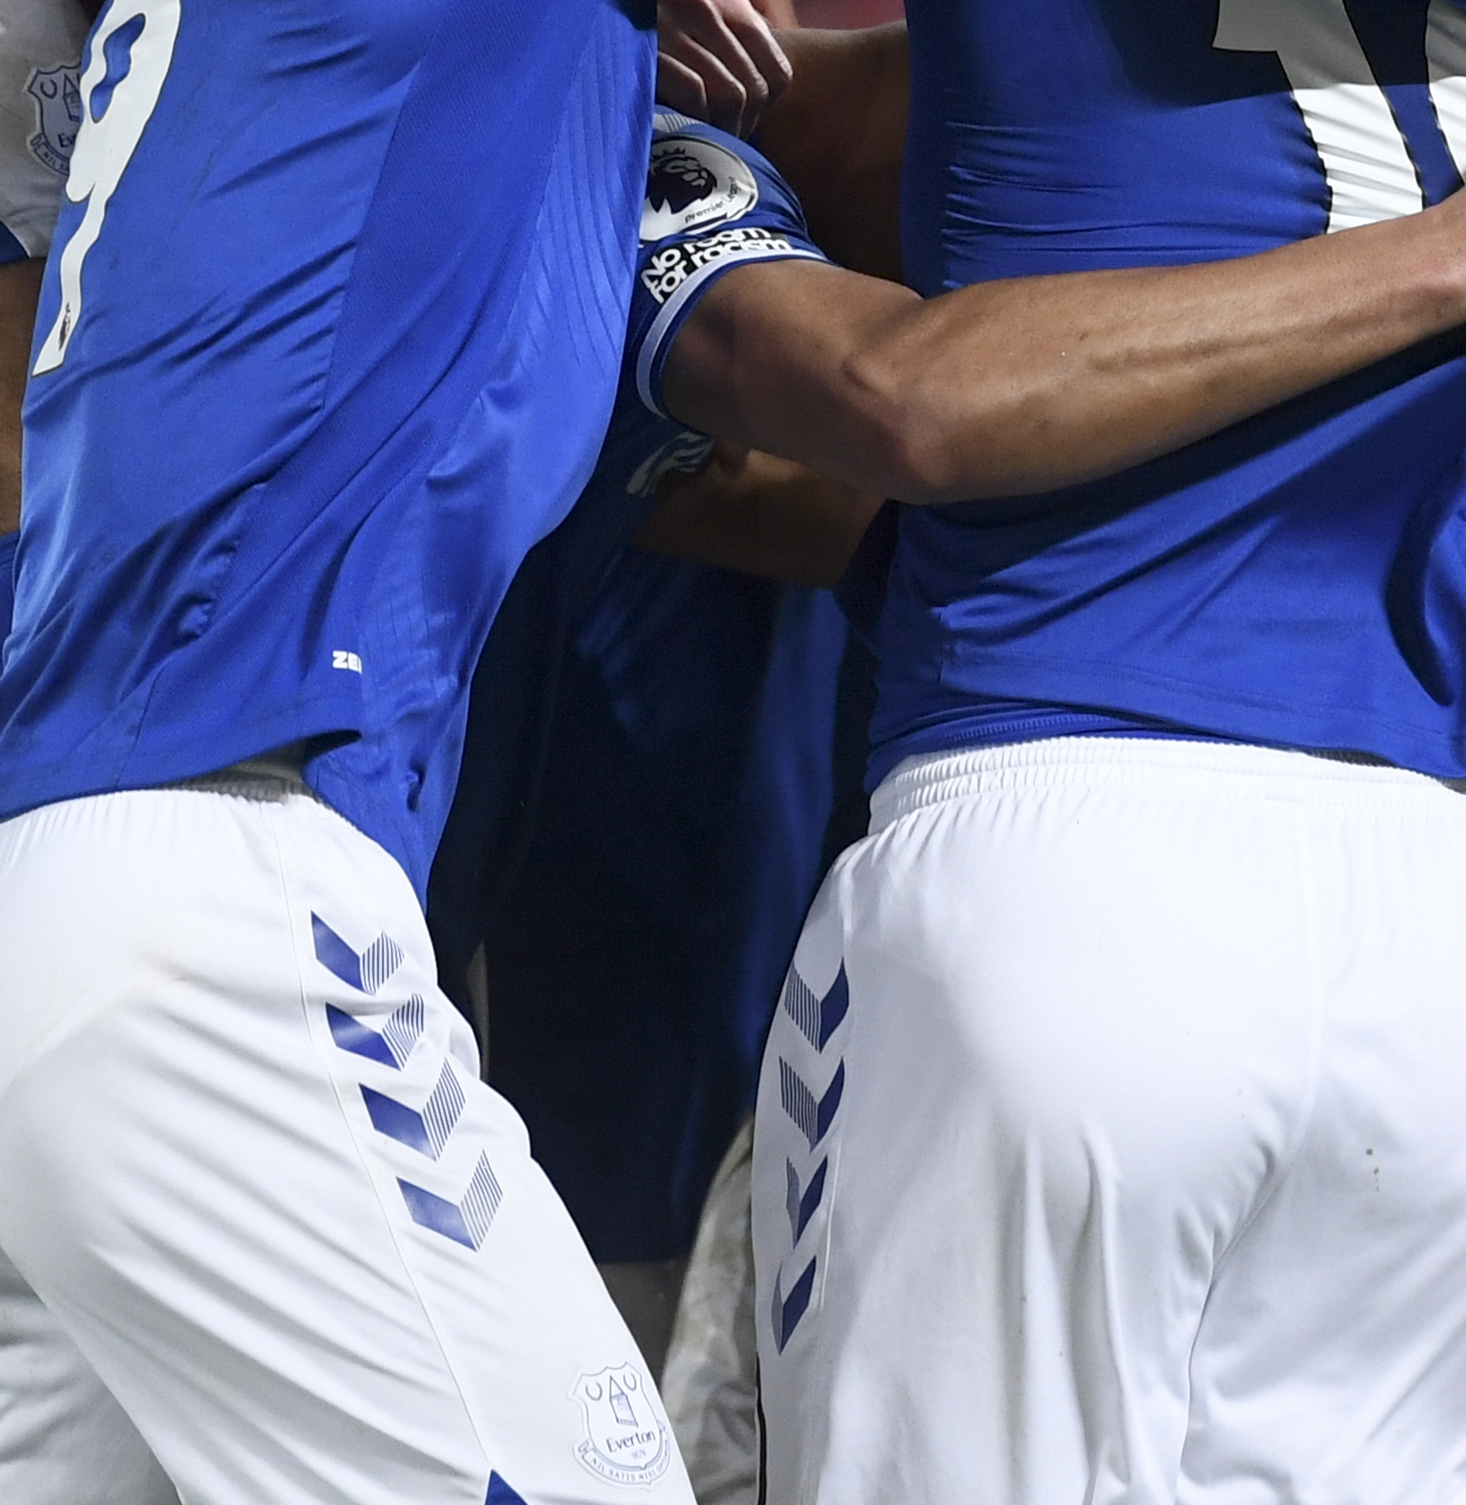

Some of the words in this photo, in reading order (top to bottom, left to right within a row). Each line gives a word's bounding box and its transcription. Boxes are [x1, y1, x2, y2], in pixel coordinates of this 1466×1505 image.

[641, 248, 681, 288] No
[650, 260, 687, 304] for
[606, 1430, 656, 1453] Everton
